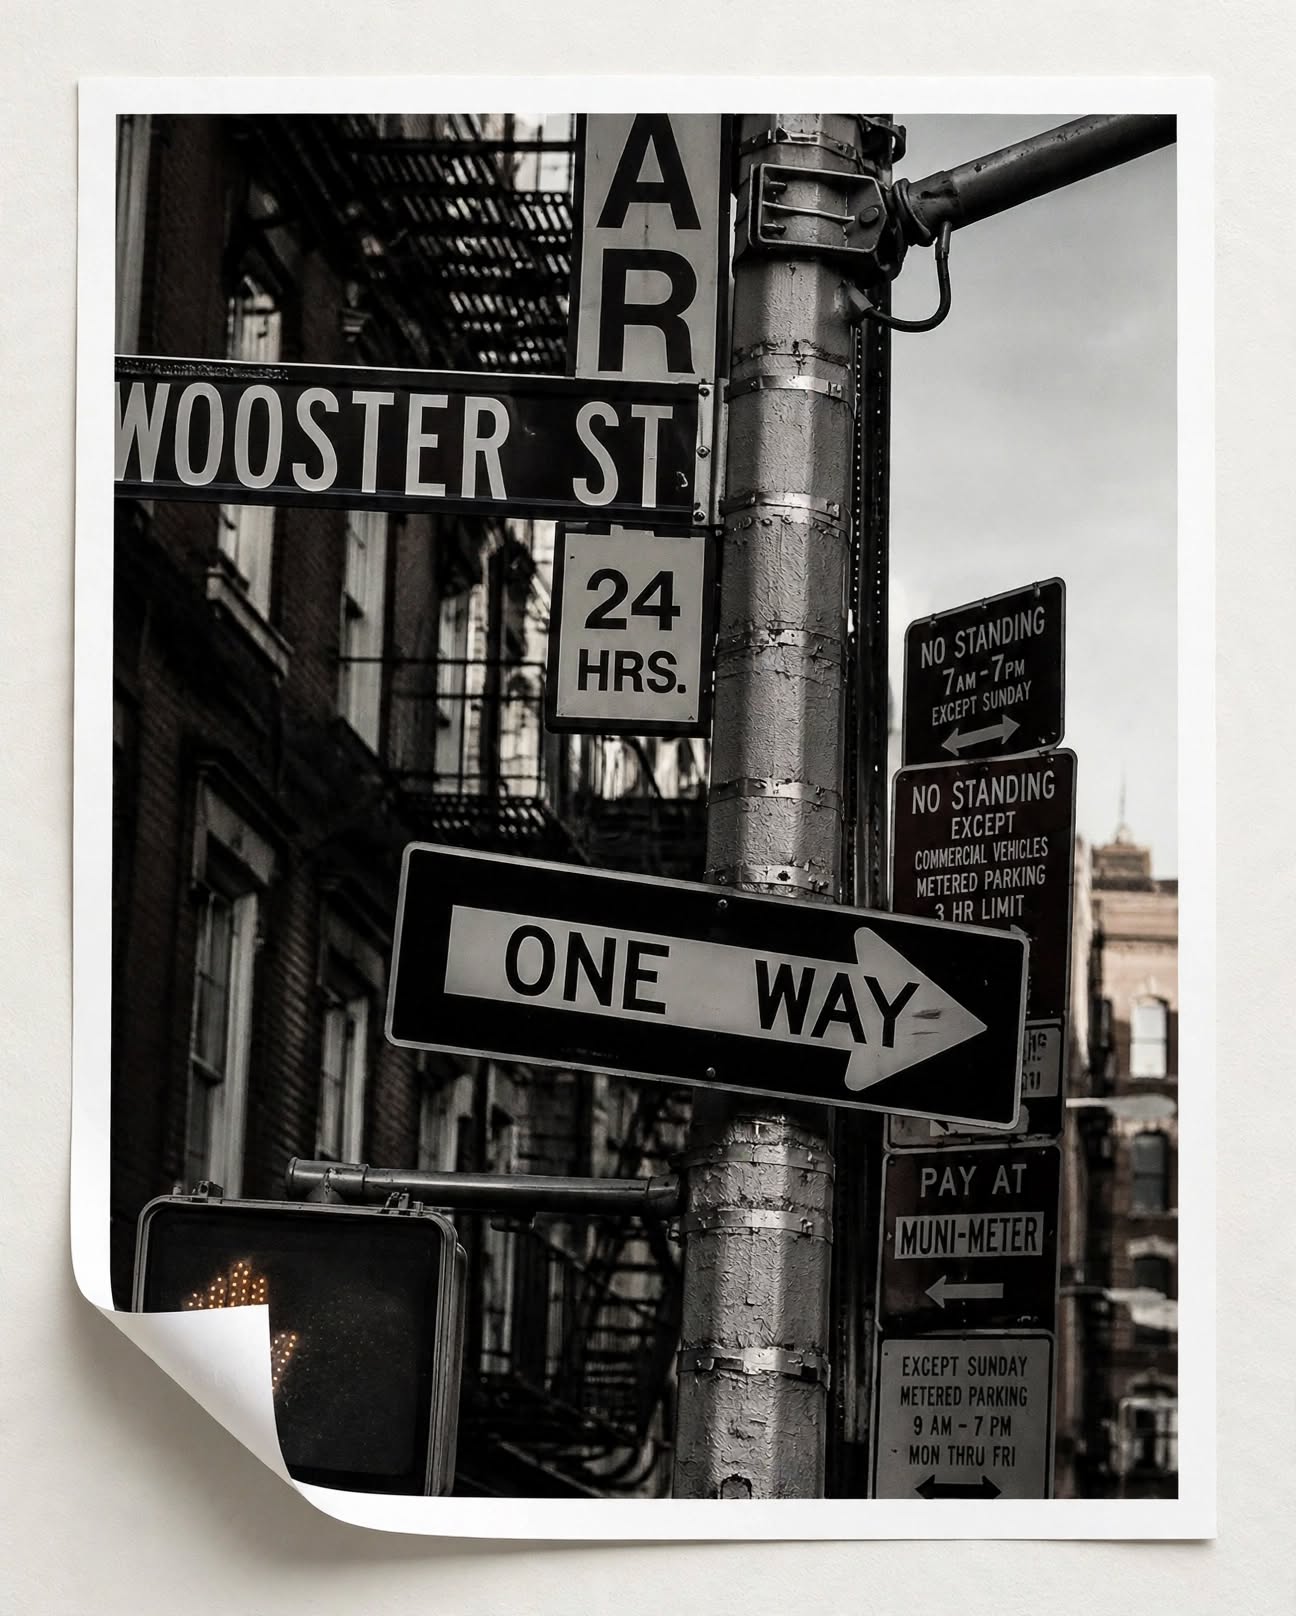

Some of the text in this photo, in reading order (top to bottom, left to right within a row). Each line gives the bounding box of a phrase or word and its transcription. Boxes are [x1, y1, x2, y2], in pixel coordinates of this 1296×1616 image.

[114, 382, 673, 508] WOOSTER ST
[584, 568, 681, 631] 24
[921, 606, 1045, 669] NO STANDING
[578, 648, 687, 694] HRS.
[932, 680, 1032, 726] EXCEPT SUNDAY
[912, 771, 1055, 815] NO STANDING
[951, 811, 1016, 840] EXCEPT
[915, 836, 1049, 871] COMMERCIAL VEHICLES
[917, 865, 1046, 898] METERED PARKING
[935, 895, 1025, 922] 3 HR LIMIT
[504, 924, 920, 1049] ONE WAY
[920, 1163, 1027, 1198] PAY AT
[900, 1217, 1038, 1255] MUNI-METER
[902, 1356, 1028, 1377] EXCEPT SUNDAY
[900, 1386, 1028, 1407] METERED PARKING
[913, 1415, 923, 1436] 9
[930, 1415, 952, 1436] AM
[974, 1415, 984, 1436] 7
[990, 1415, 1012, 1437] PM
[909, 1445, 1016, 1467] MON THRU FRI
